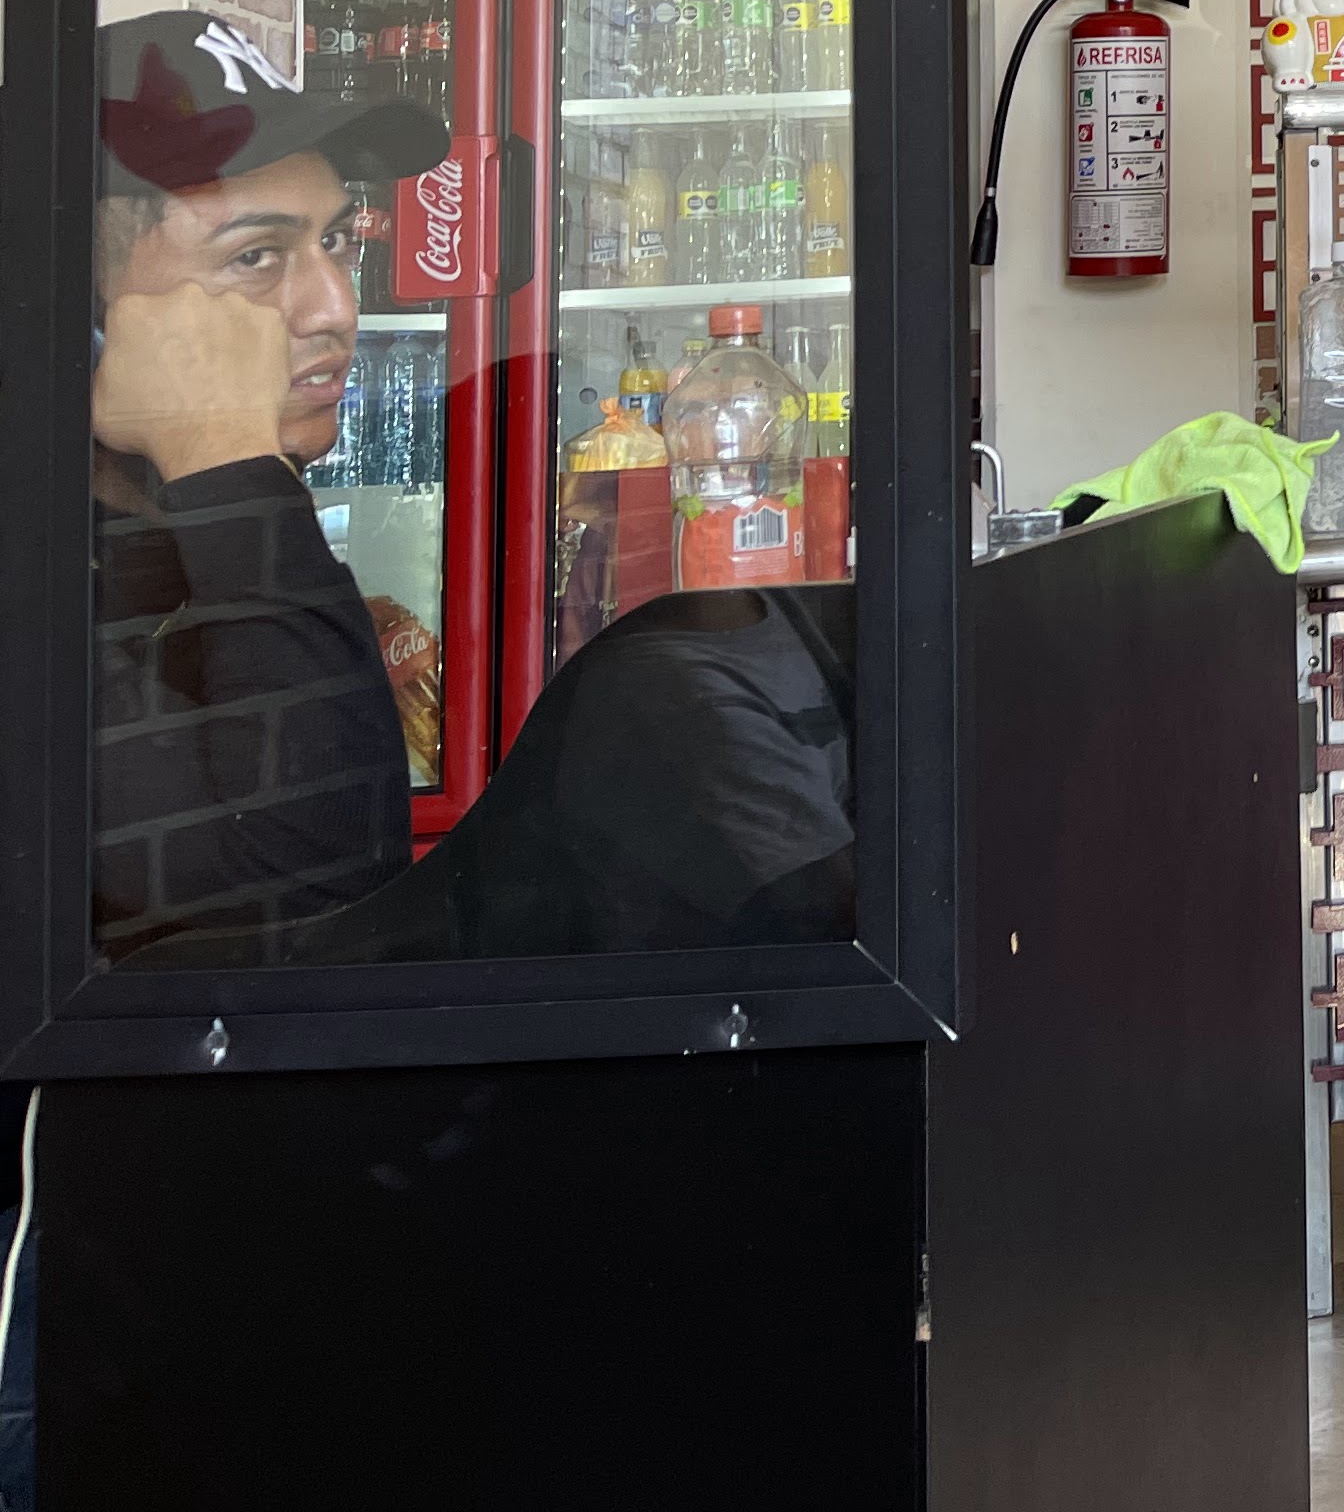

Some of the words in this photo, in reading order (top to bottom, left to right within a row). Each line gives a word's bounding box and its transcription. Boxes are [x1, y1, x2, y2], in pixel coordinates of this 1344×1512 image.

[1110, 90, 1117, 103] 1
[1110, 121, 1118, 133] 2
[1111, 158, 1119, 170] 3
[415, 158, 463, 282] Coca-Cola
